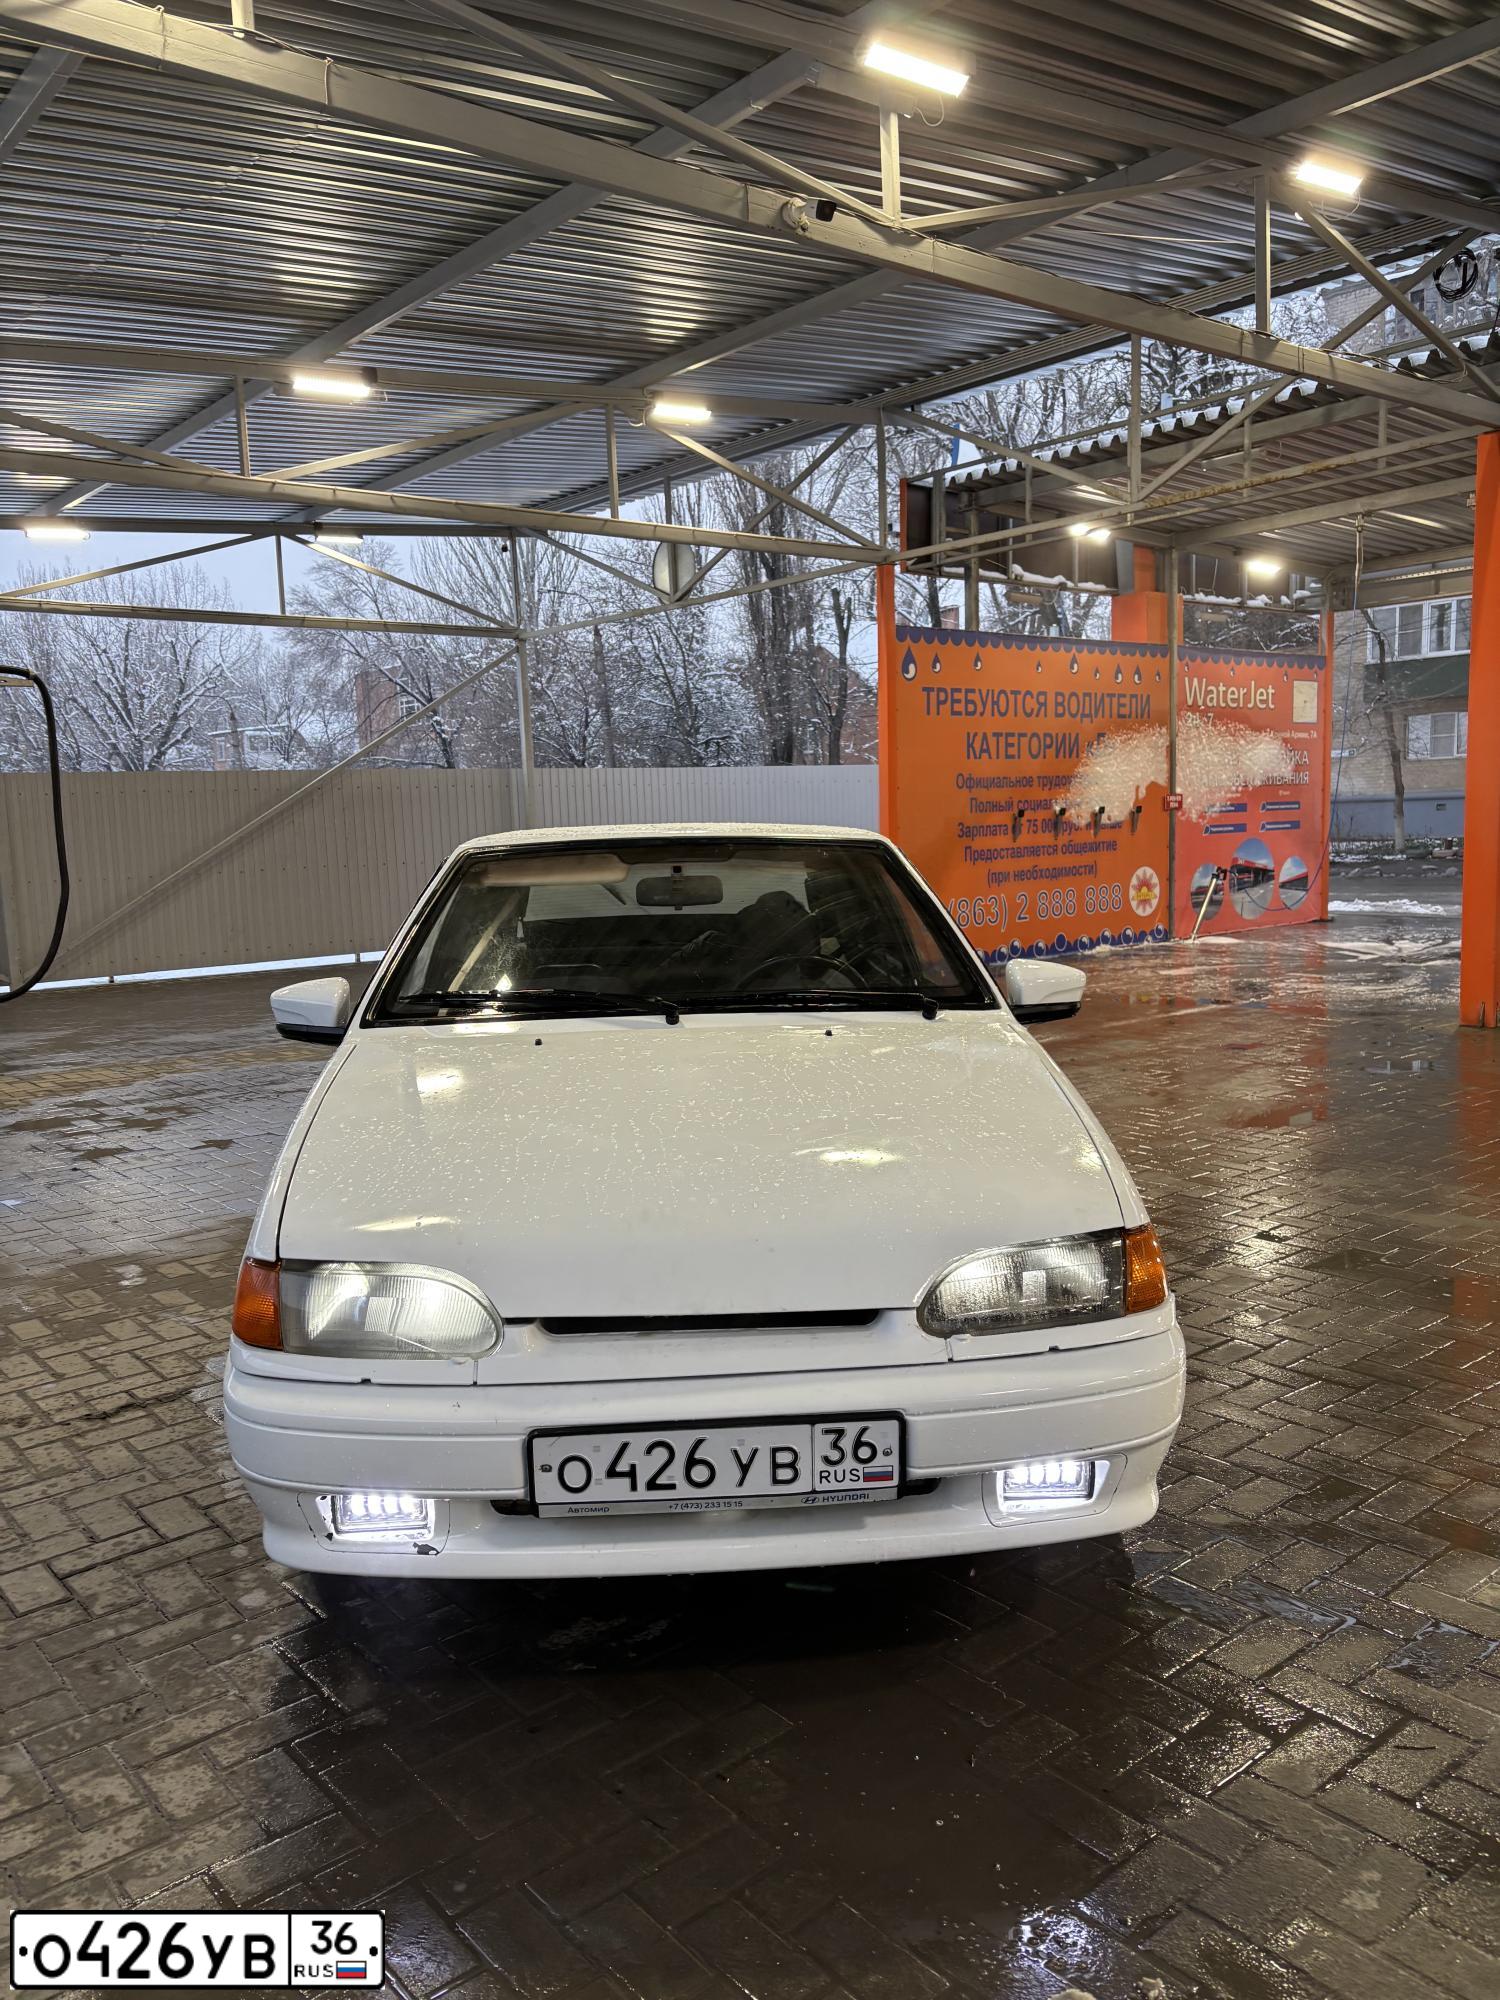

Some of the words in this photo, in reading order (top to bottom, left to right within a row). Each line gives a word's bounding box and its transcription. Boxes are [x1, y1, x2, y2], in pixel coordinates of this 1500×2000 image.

[922, 687, 1048, 719] ТРЕБУЮТСЯ
[1055, 691, 1151, 723] ВОДИТЕЛИ
[1184, 677, 1275, 709] WaterJet
[966, 732, 1080, 760] КАТЕГОРИИ
[956, 773, 1033, 792] Официальное
[970, 797, 1013, 815] Полный
[957, 822, 1008, 841] Зарплата
[1026, 820, 1039, 835] 75
[964, 846, 1058, 866] Предоставляется
[1061, 838, 1117, 856] общежитие
[987, 868, 1011, 888] (при
[1013, 860, 1098, 883] необходимости)
[1016, 891, 1029, 923] 2
[1037, 887, 1077, 920] 888
[1085, 882, 1123, 915] 888
[820, 1426, 879, 1467] 36
[819, 1468, 861, 1485] RUS
[680, 1502, 702, 1511] (473)
[704, 1501, 721, 1509] 233
[734, 1500, 743, 1508] 15
[822, 1493, 870, 1504] HYUNDAI
